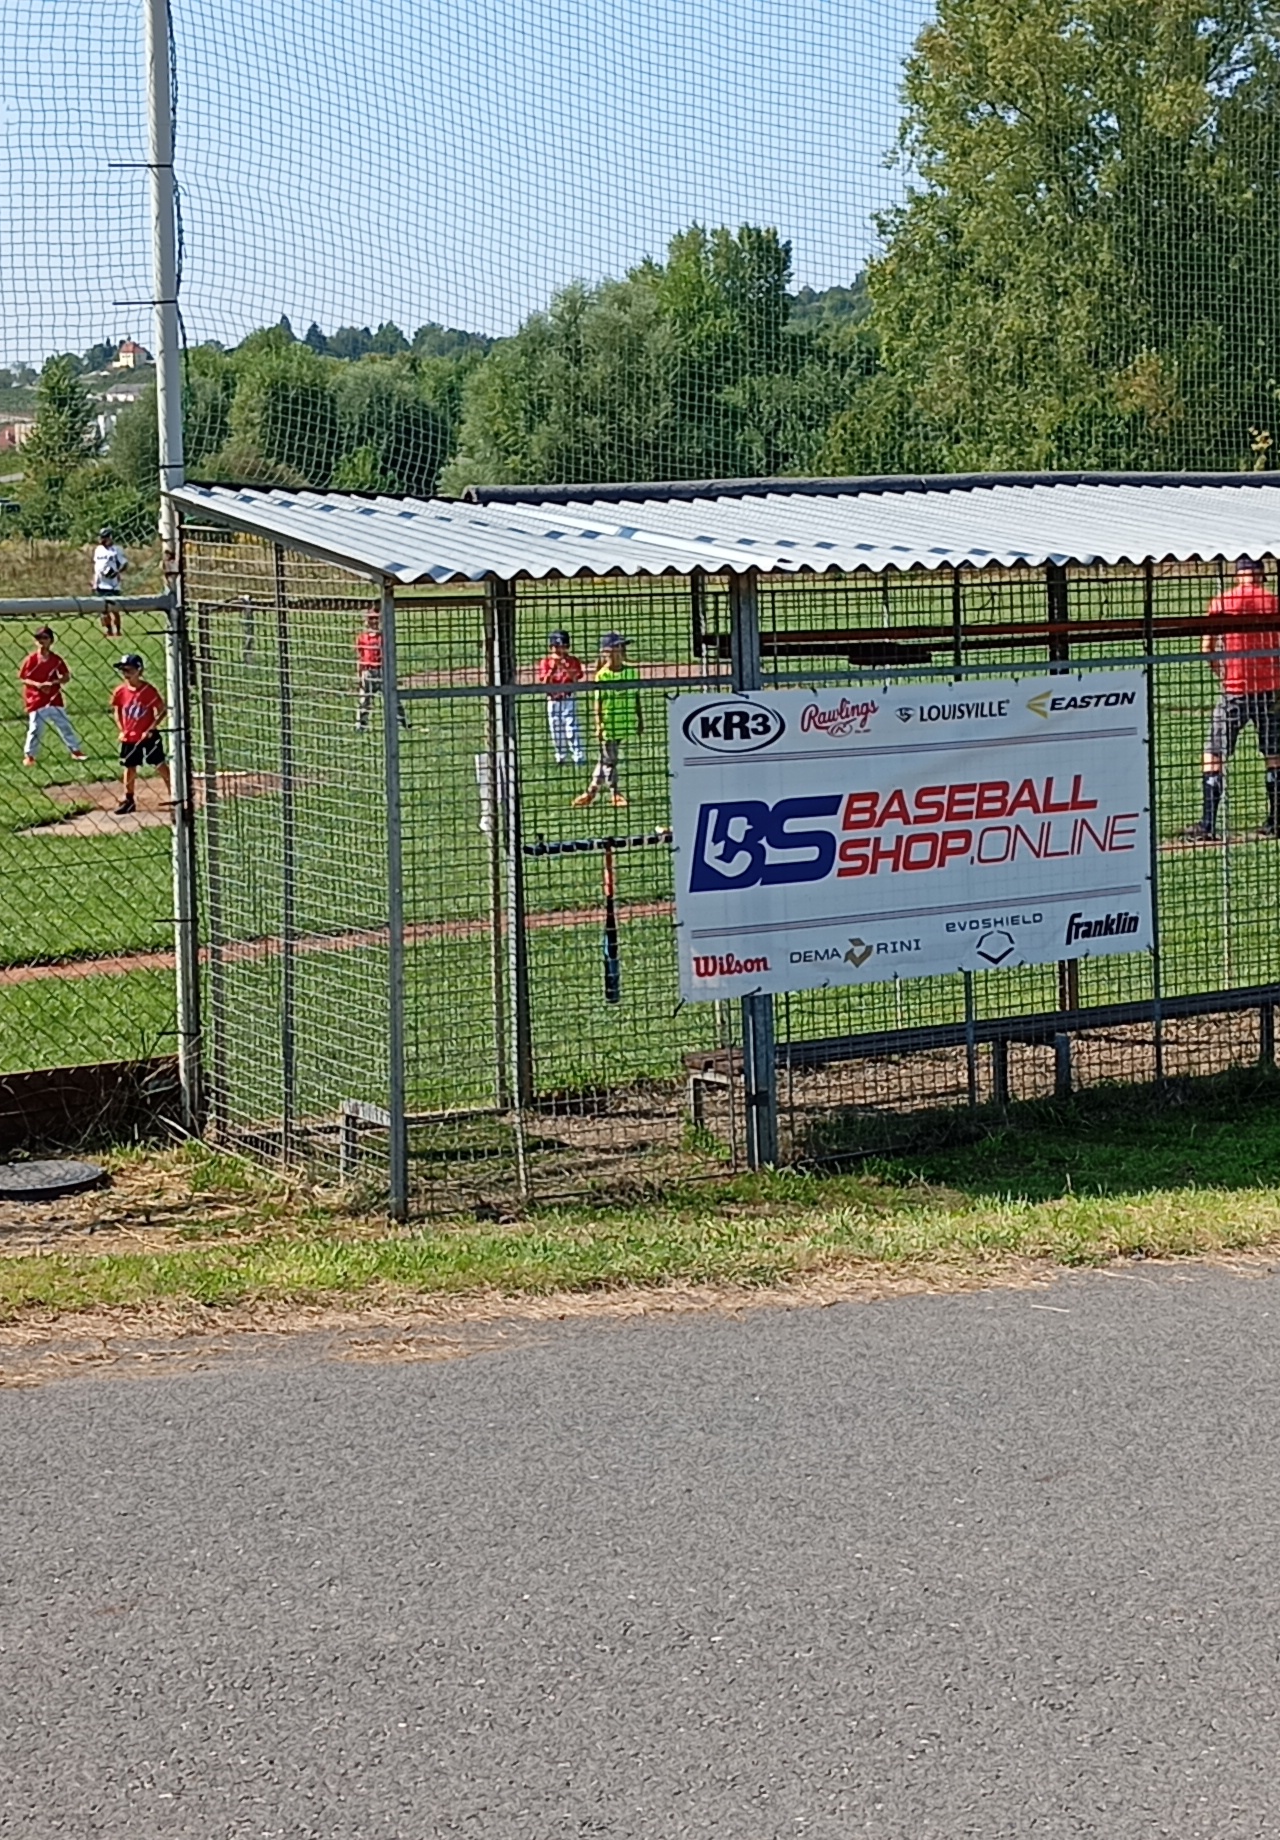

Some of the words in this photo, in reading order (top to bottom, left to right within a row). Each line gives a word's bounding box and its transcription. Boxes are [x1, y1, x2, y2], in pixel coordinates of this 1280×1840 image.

[800, 698, 880, 732] Rawlings
[919, 701, 1008, 722] LOUISVILLE
[1049, 691, 1136, 713] EASTON
[700, 709, 772, 741] KR3
[841, 774, 1099, 831] BASEBALL
[689, 794, 843, 893] BS
[693, 953, 771, 978] Wilson
